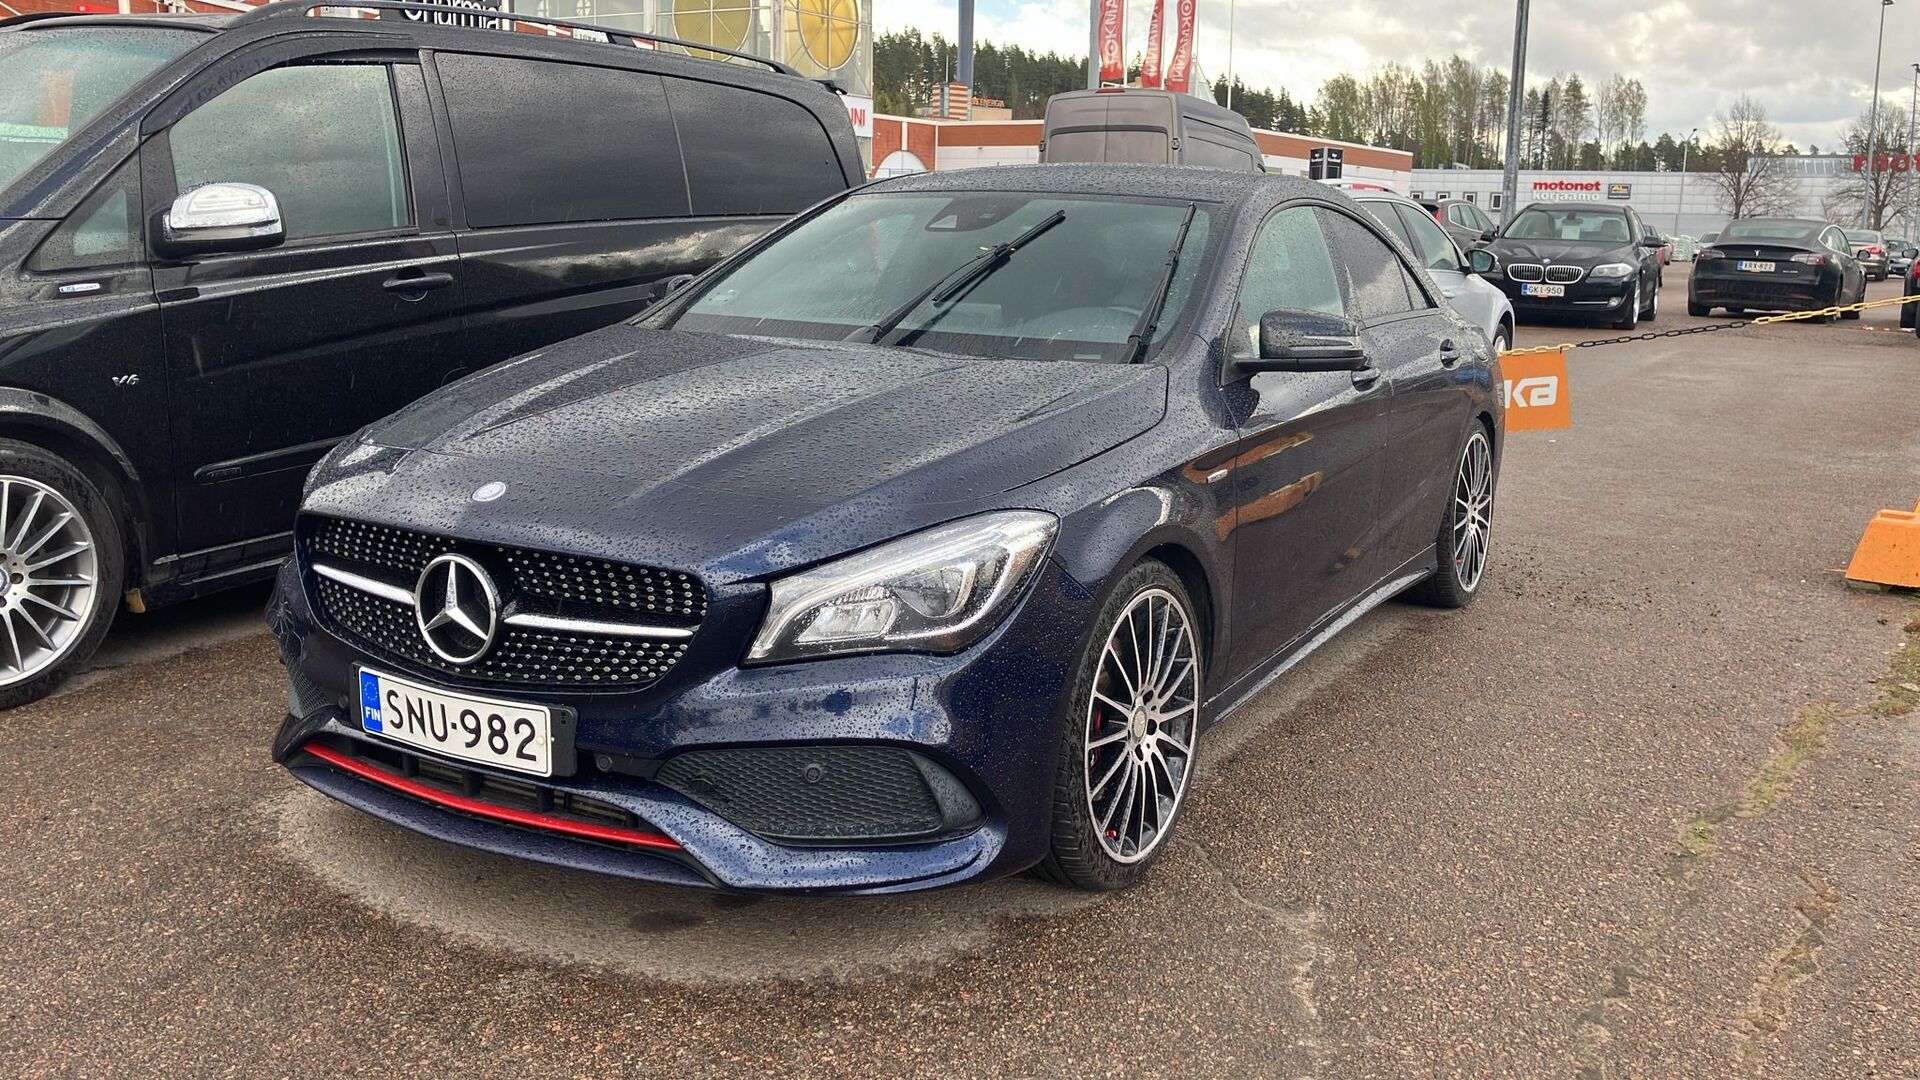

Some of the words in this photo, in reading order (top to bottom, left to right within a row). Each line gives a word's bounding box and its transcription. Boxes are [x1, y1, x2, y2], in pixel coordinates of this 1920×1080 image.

[1533, 180, 1600, 191] motonet
[1533, 191, 1599, 202] korjaamo
[365, 707, 382, 722] FIN
[386, 689, 537, 762] SNU-982
